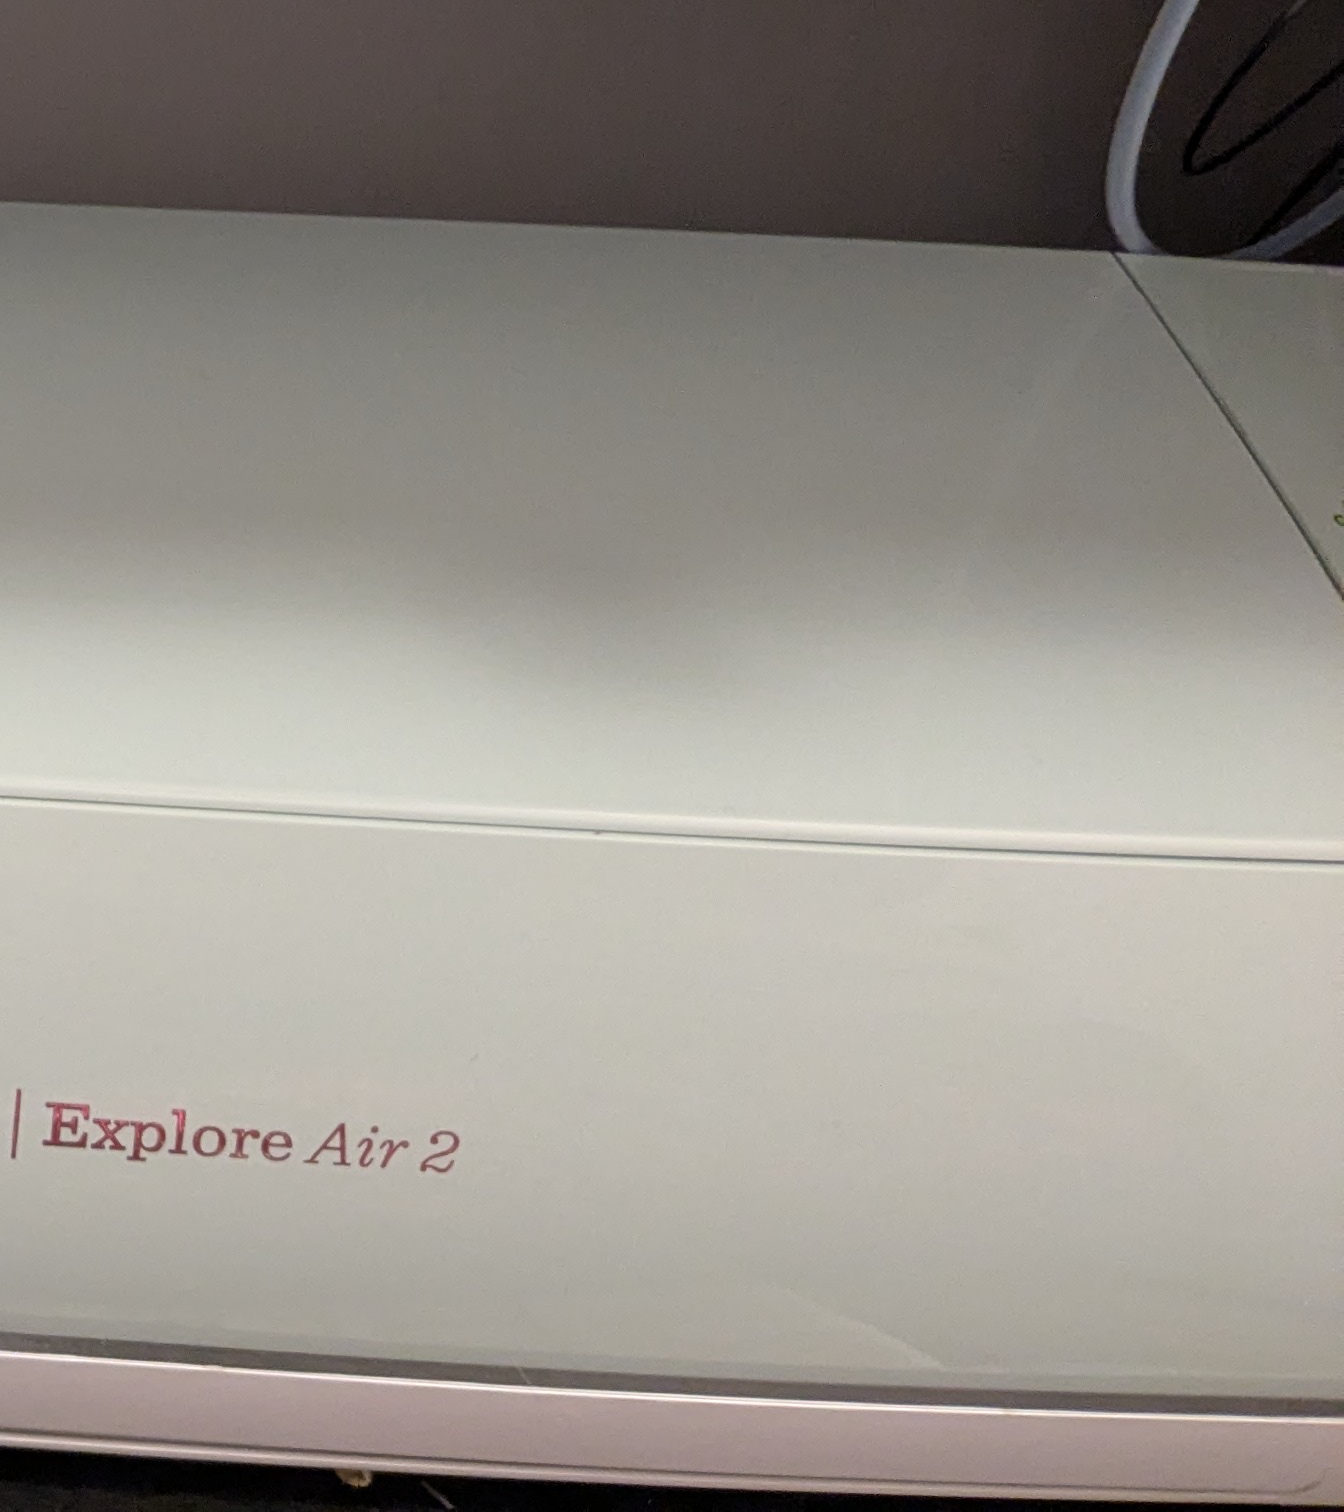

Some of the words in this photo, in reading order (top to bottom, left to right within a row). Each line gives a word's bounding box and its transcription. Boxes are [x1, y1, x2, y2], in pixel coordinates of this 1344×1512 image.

[41, 1101, 294, 1164] Explore
[302, 1123, 411, 1170] Air
[419, 1129, 461, 1174] 2
